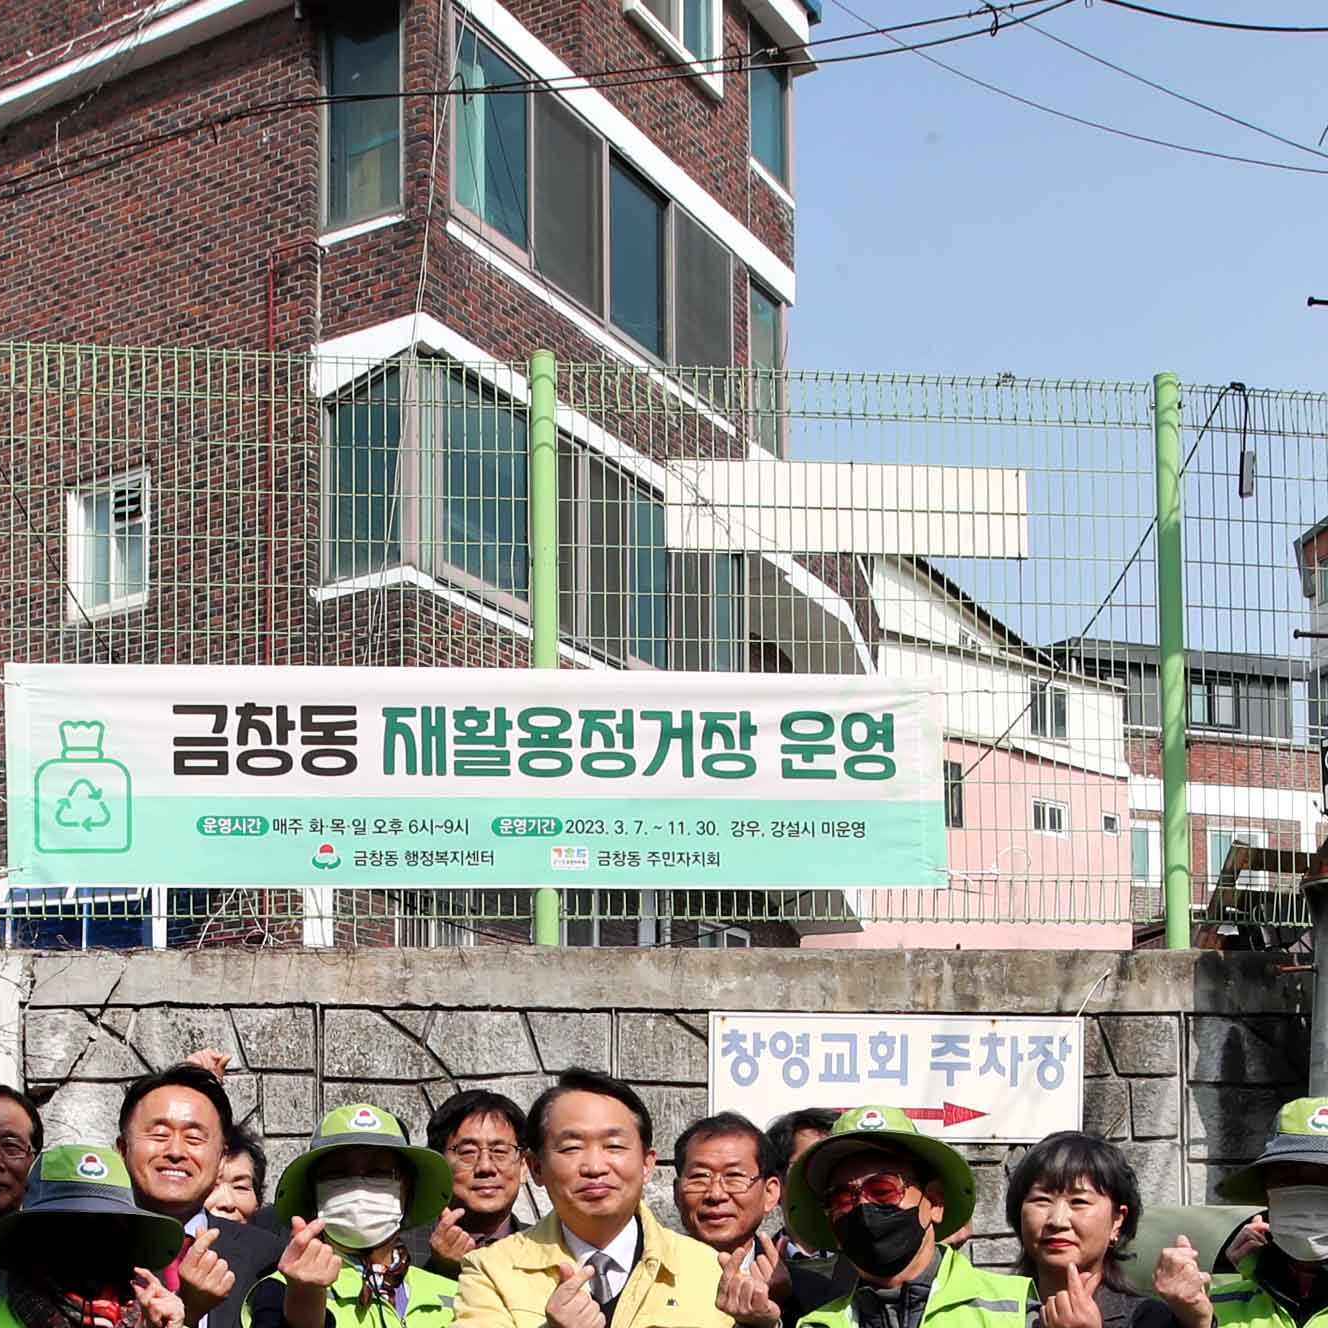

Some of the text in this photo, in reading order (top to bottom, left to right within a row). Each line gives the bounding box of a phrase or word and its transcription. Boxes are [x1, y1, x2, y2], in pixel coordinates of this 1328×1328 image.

[172, 702, 897, 781] 금창동 재활용정거장 운영
[202, 815, 470, 836] 운영시간 매주 화·목·일 오후 6시~9시
[498, 817, 557, 835] 운영기간
[564, 819, 609, 836] 2023.
[613, 819, 629, 836] 3.
[633, 819, 649, 837] 7.
[668, 819, 691, 837] 11.
[695, 820, 720, 837] 30.
[730, 819, 766, 838] 강우,
[771, 819, 816, 838] 강설시
[821, 820, 867, 839] 미운영
[353, 849, 495, 867] 금창동 행정복지센터
[596, 850, 721, 868] 금창동 주민자치회
[720, 1028, 1073, 1090] 창영교회 주차장
